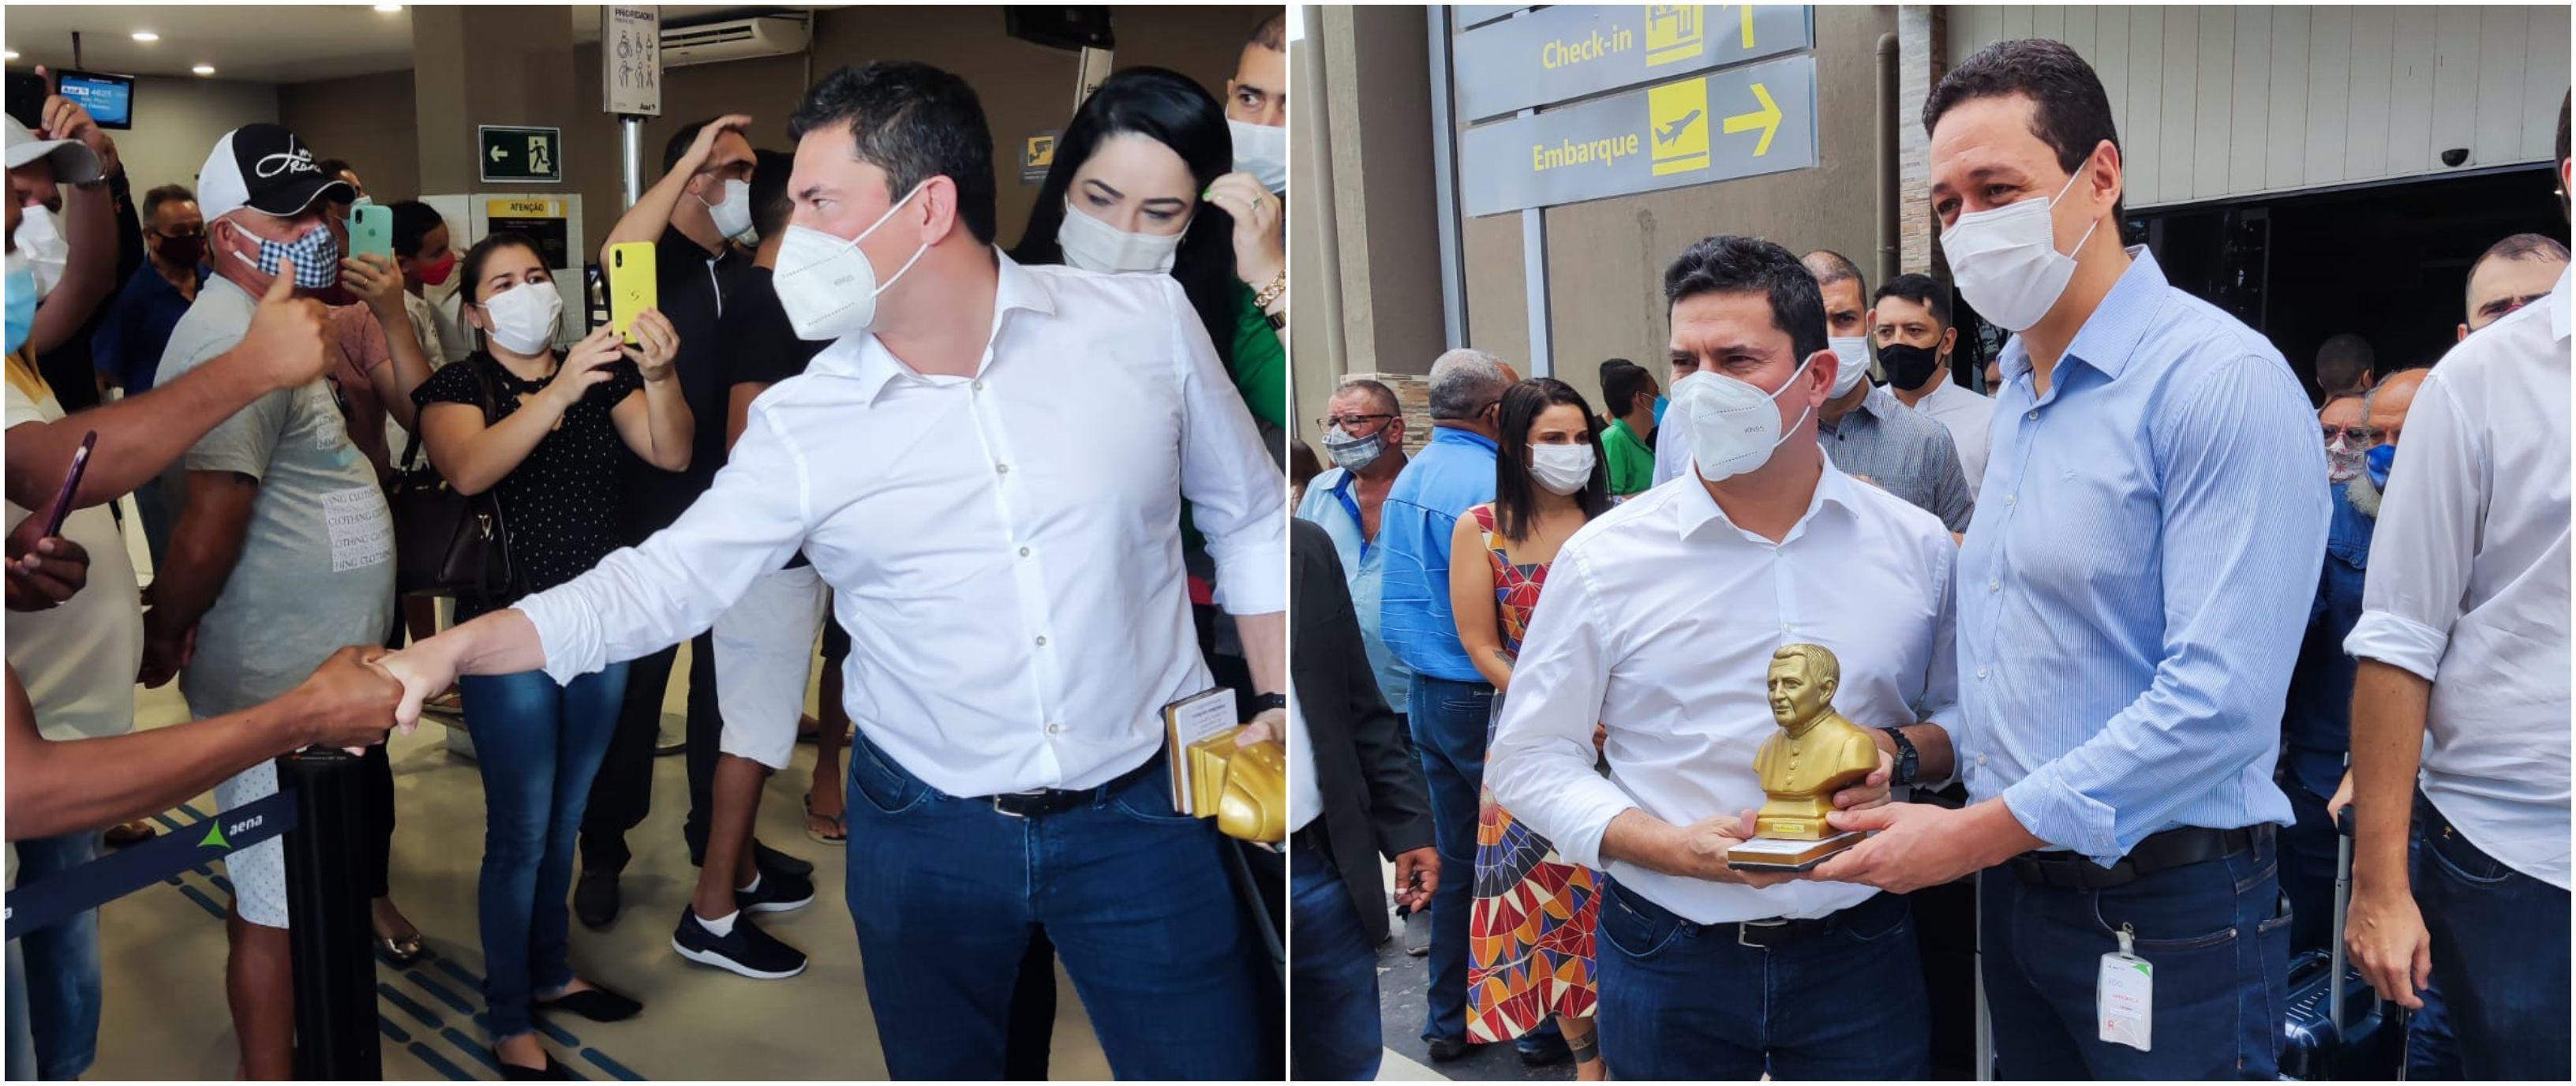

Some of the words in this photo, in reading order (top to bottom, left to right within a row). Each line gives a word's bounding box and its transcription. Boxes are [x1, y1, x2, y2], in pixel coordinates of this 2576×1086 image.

[1542, 24, 1633, 69] Check-in
[1533, 133, 1639, 171] Embarque
[510, 202, 545, 213] ATENÇÃO
[229, 814, 263, 837] aena
